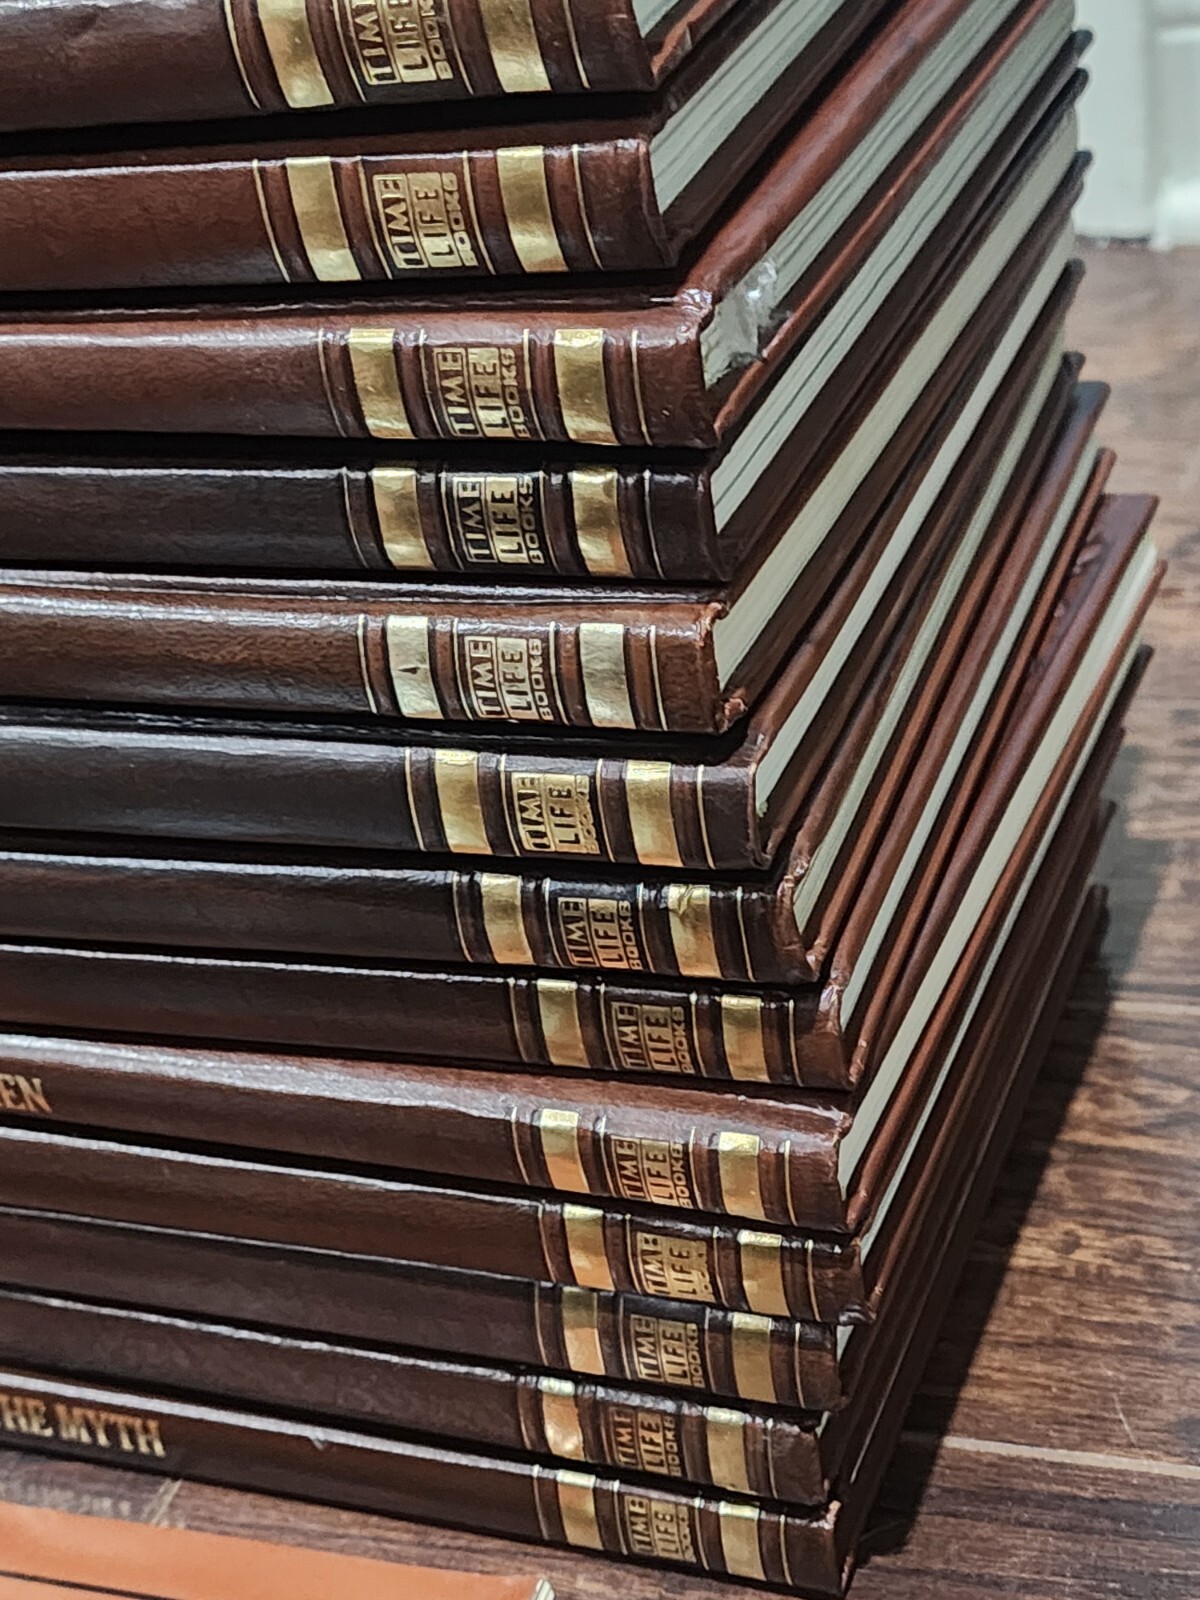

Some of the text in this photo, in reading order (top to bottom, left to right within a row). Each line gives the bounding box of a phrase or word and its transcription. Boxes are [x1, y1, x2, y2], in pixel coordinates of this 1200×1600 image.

[380, 177, 426, 266] TIME
[415, 189, 455, 257] LIFE
[441, 172, 478, 266] BOOKS
[439, 351, 475, 434] TIME
[472, 360, 509, 430] LIFE
[500, 348, 530, 438] BOOKS
[459, 480, 492, 557] TIME
[491, 489, 524, 558] LIFE
[519, 475, 545, 564] BOOKS
[470, 640, 504, 714] TIME
[501, 649, 533, 712] LIFE
[529, 638, 554, 720] BOOKS
[519, 777, 551, 849] TIME
[549, 786, 581, 846] LIFE
[561, 900, 595, 965] TIME
[595, 909, 624, 964] LIFE
[618, 900, 643, 970] BOOKS
[617, 1004, 648, 1068] TIME
[644, 1014, 677, 1068] LIFE
[671, 1006, 695, 1074] BOOKS
[616, 1140, 646, 1199] TIME
[645, 1149, 674, 1202] LIFE
[670, 1142, 693, 1209] BOOKS
[642, 1235, 671, 1296] TIME
[669, 1246, 698, 1296] LIFE
[635, 1318, 660, 1380] TIME
[663, 1328, 689, 1380] LIFE
[686, 1322, 705, 1388] BOOKS
[55, 1402, 166, 1458] MYTH
[612, 1410, 637, 1467] TIME
[640, 1418, 666, 1470] LIFE
[663, 1415, 681, 1477] BOOKS
[629, 1498, 654, 1553] TIME
[653, 1510, 680, 1555] LIFE
